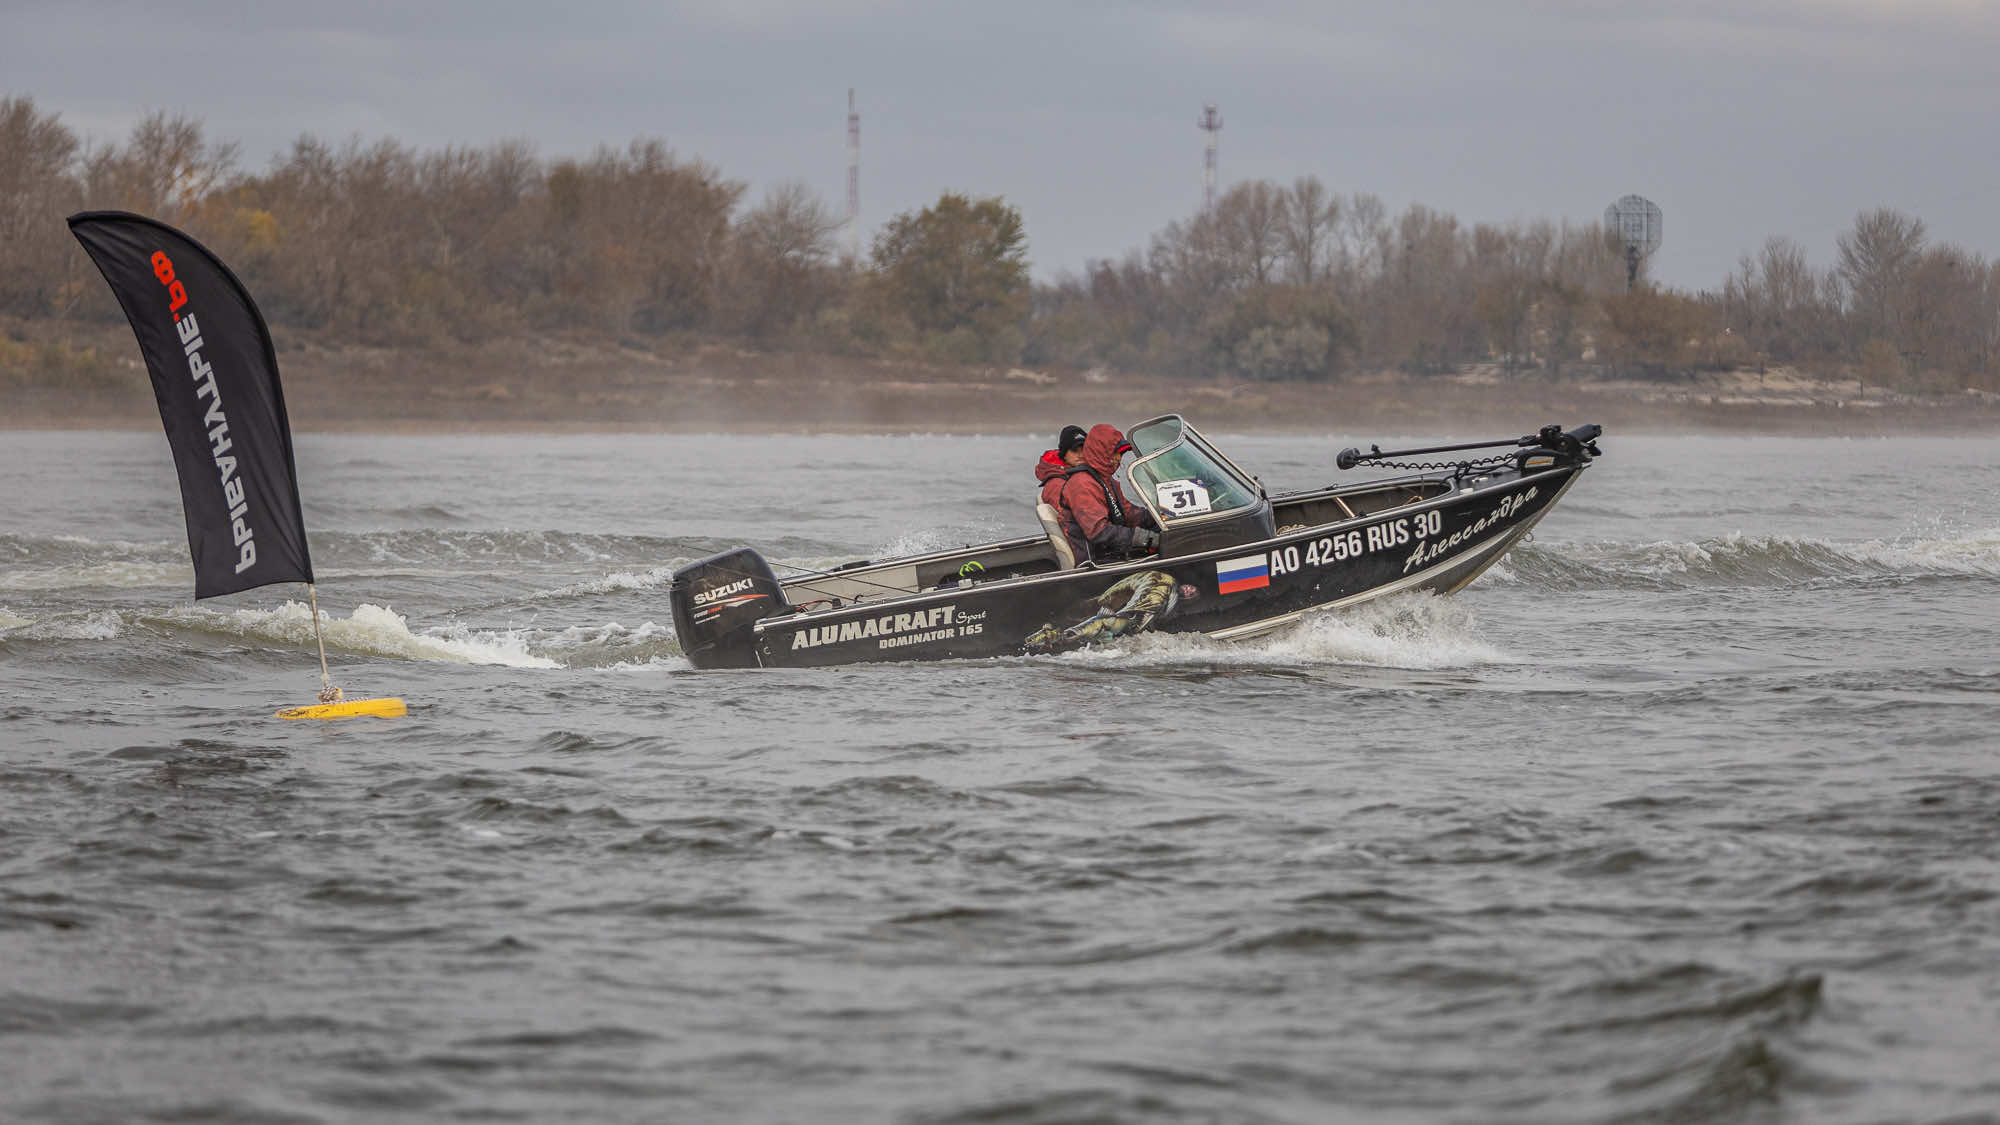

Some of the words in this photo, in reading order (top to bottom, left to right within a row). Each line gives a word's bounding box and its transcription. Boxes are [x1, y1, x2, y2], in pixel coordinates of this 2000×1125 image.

[1171, 489, 1197, 509] 31
[1305, 530, 1363, 567] 4256
[1367, 518, 1409, 553] RUS
[1413, 509, 1441, 540] 30
[1402, 486, 1539, 574] Александра
[693, 577, 754, 605] SUZUKI
[791, 604, 957, 651] ALUMACRAFT
[955, 610, 987, 625] Sport
[879, 628, 955, 650] DOMINATOR
[958, 623, 983, 637] 165
